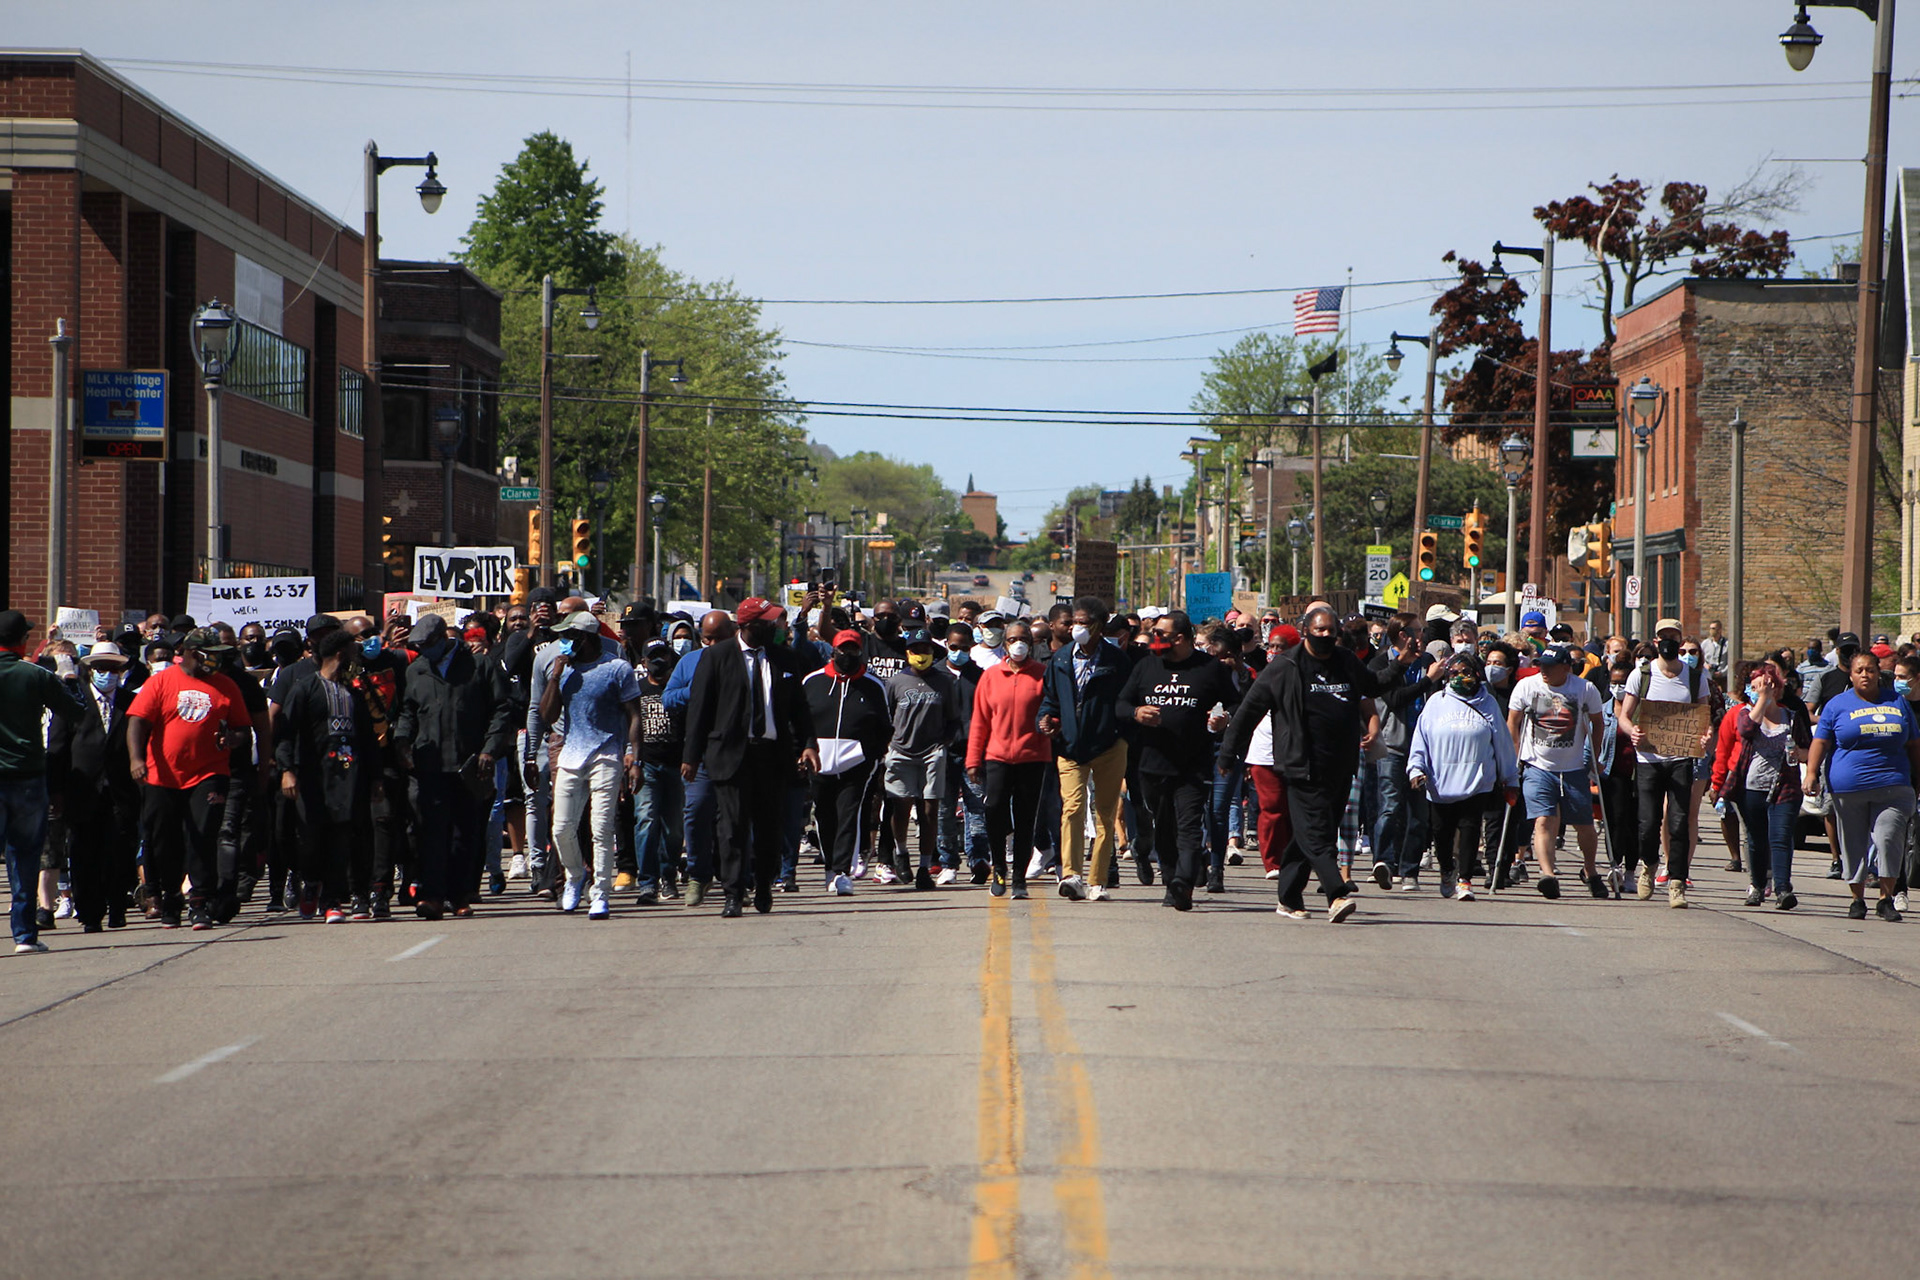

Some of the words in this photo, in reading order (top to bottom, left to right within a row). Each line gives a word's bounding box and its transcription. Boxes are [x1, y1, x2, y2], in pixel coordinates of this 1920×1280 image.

[87, 374, 110, 384] MLK
[115, 374, 161, 388] Heritage
[86, 387, 121, 397] Health
[125, 387, 162, 398] Center
[1576, 389, 1614, 400] OAAA
[102, 427, 130, 435] Patients
[133, 427, 162, 435] Welcome
[107, 442, 142, 456] OPEN
[506, 489, 532, 499] Clarke
[1433, 517, 1456, 526] Clarke
[1369, 569, 1389, 581] 20
[212, 586, 255, 599] LUKE
[264, 583, 309, 598] 25-37
[1202, 583, 1225, 593] FREE
[1190, 596, 1213, 605] UNTIL
[232, 605, 258, 615] WHICH
[625, 605, 633, 616] P
[1366, 608, 1385, 617] BLACK
[872, 656, 905, 669] CAN'T
[1171, 674, 1178, 682] I
[1154, 684, 1190, 694] CAN'T
[1145, 695, 1198, 707] BREATHE
[1650, 715, 1699, 735] POLITICS
[1551, 740, 1575, 748] HOOD
[1649, 732, 1665, 743] THIS
[1667, 735, 1673, 743] IS
[1673, 734, 1698, 749] LIFE
[1660, 743, 1689, 756] DEATH
